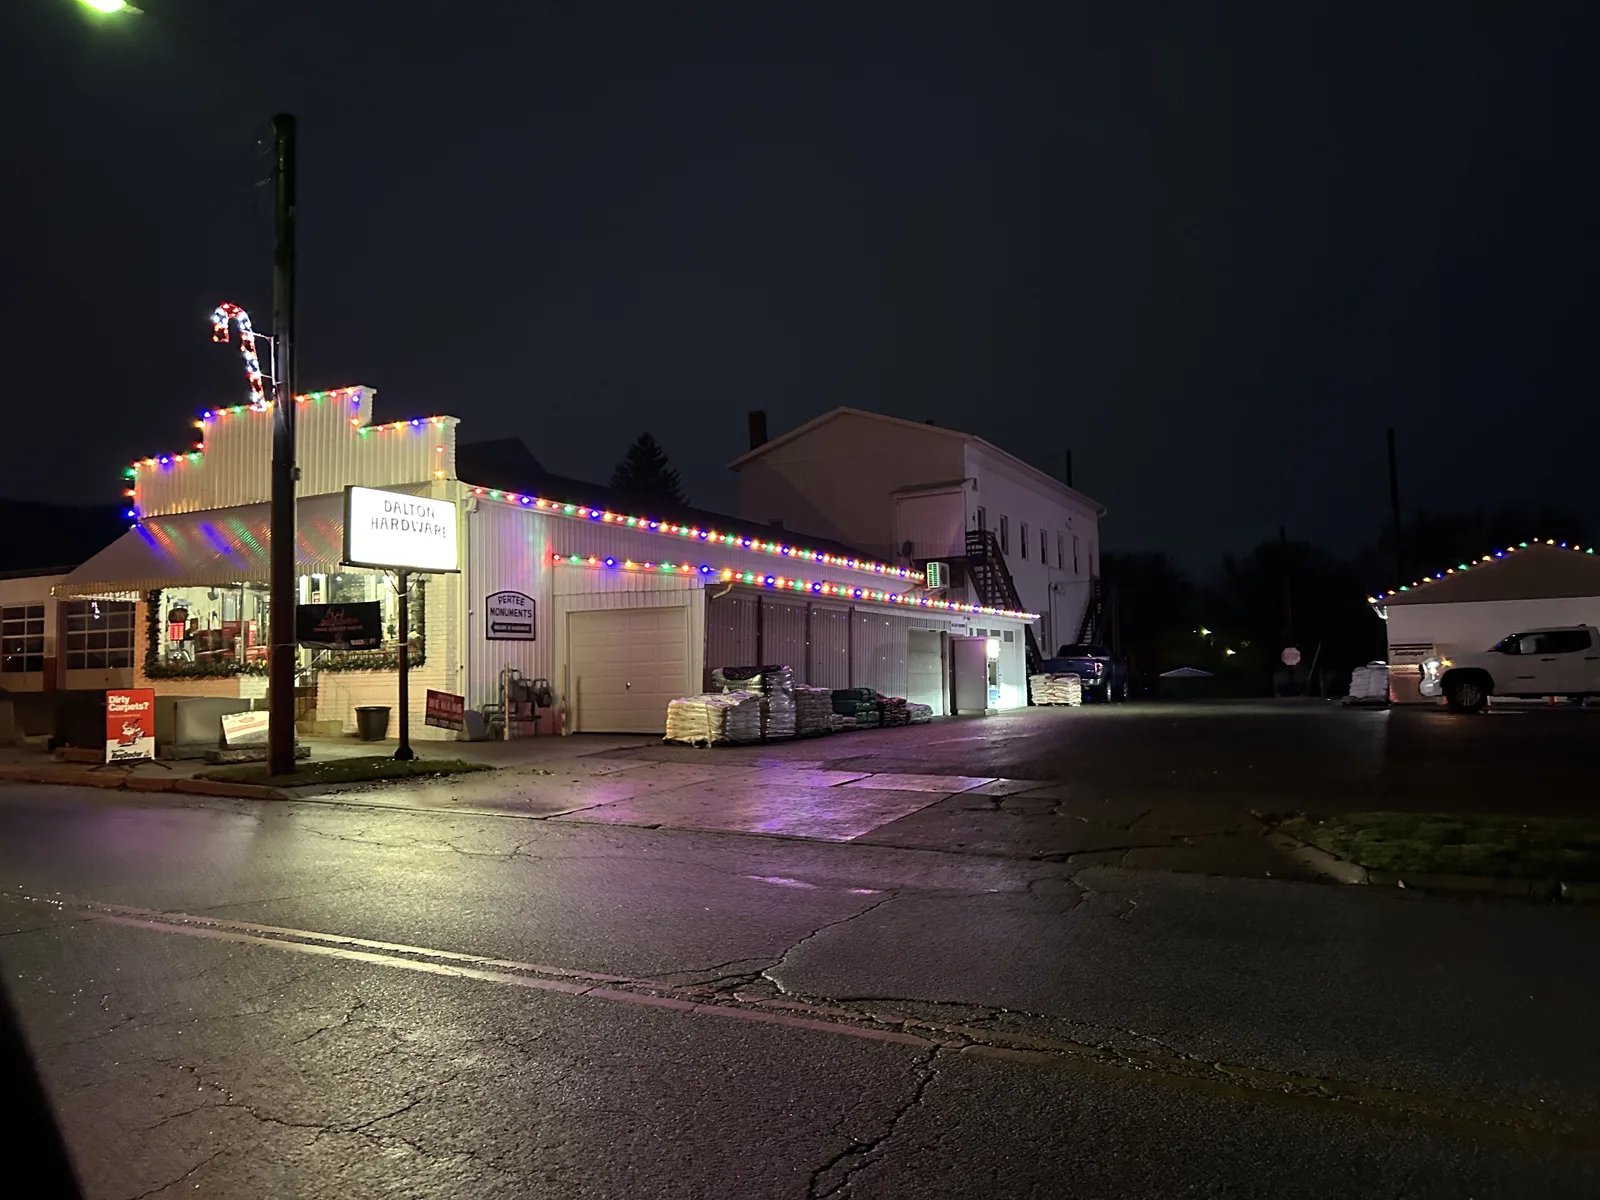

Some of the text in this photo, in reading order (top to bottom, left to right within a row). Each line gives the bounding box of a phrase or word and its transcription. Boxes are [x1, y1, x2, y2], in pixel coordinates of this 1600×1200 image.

[384, 500, 435, 518] DALTON
[371, 517, 447, 539] HARDWARE
[490, 607, 532, 618] MONUMENTS
[108, 695, 130, 704] Dirty
[108, 702, 149, 712] Carpets?
